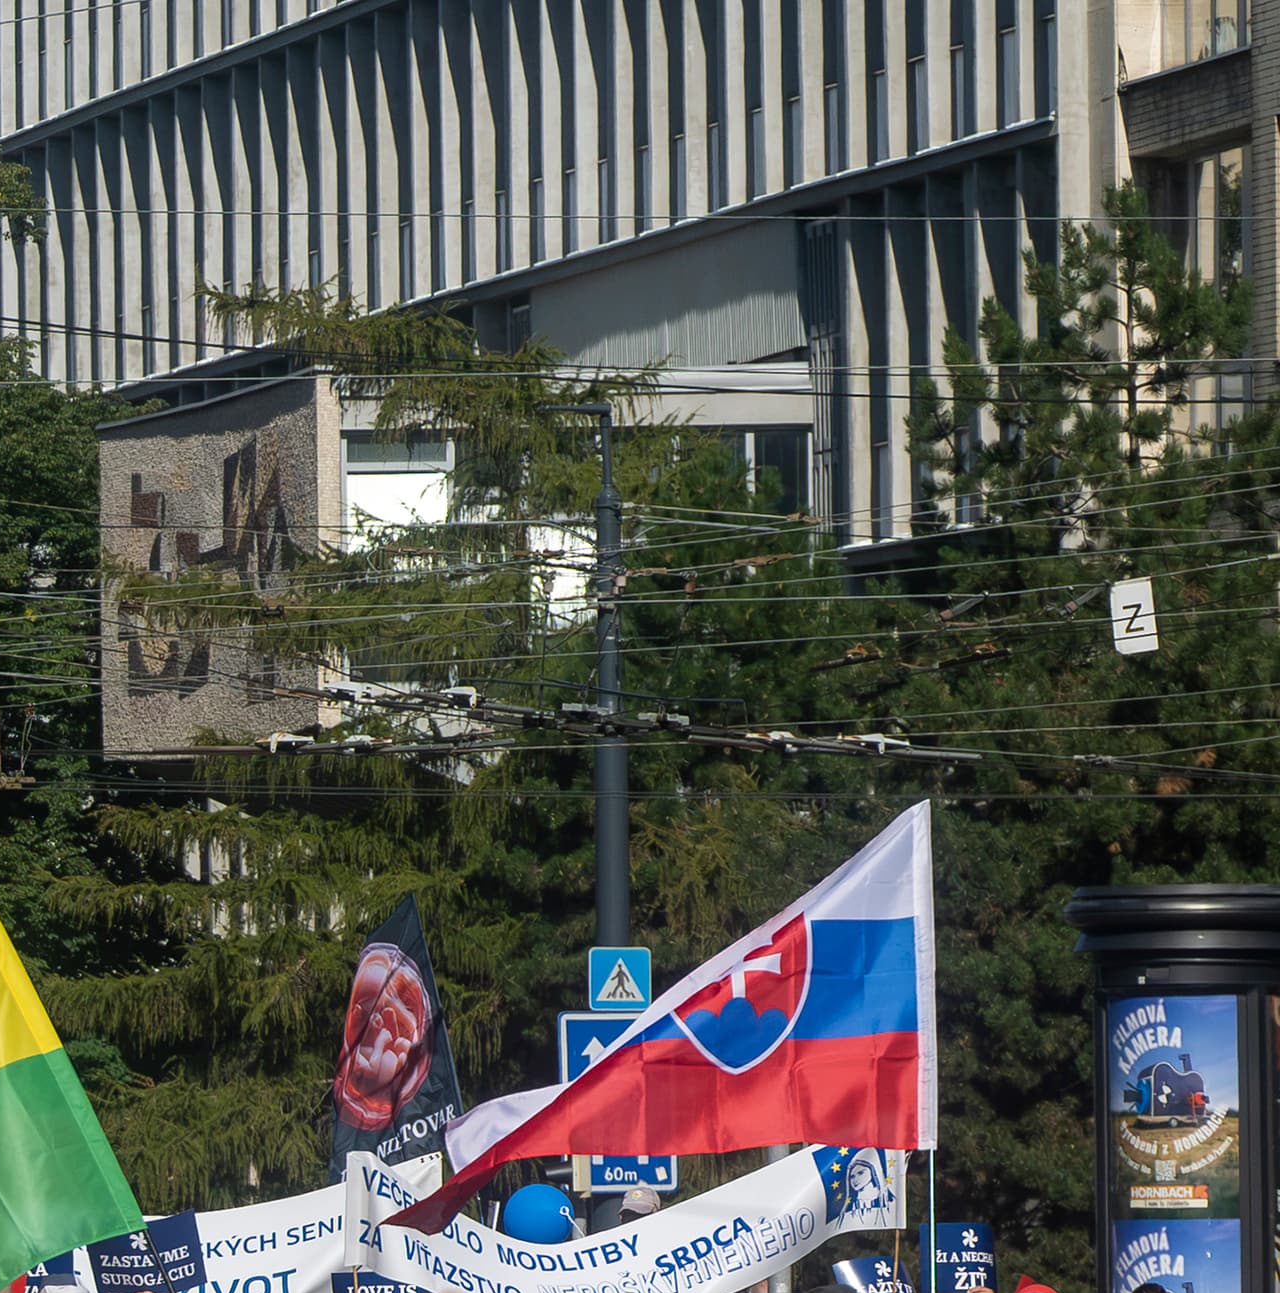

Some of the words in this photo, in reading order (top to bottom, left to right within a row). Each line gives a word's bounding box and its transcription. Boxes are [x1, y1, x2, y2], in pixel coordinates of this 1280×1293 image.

[1122, 603, 1144, 633] Z
[1113, 998, 1166, 1050] FILMOVÁ
[1118, 1026, 1182, 1075] KAMERA
[604, 1167, 637, 1181] 60m
[1130, 1186, 1193, 1199] HORNBACH
[357, 1218, 383, 1254] ZA
[496, 1234, 639, 1273] MODLITBY
[655, 1216, 753, 1277] SRDCA
[1116, 1226, 1170, 1277] FILMOVÁ
[951, 1252, 960, 1262] A
[955, 1267, 988, 1291] ŽIŤ
